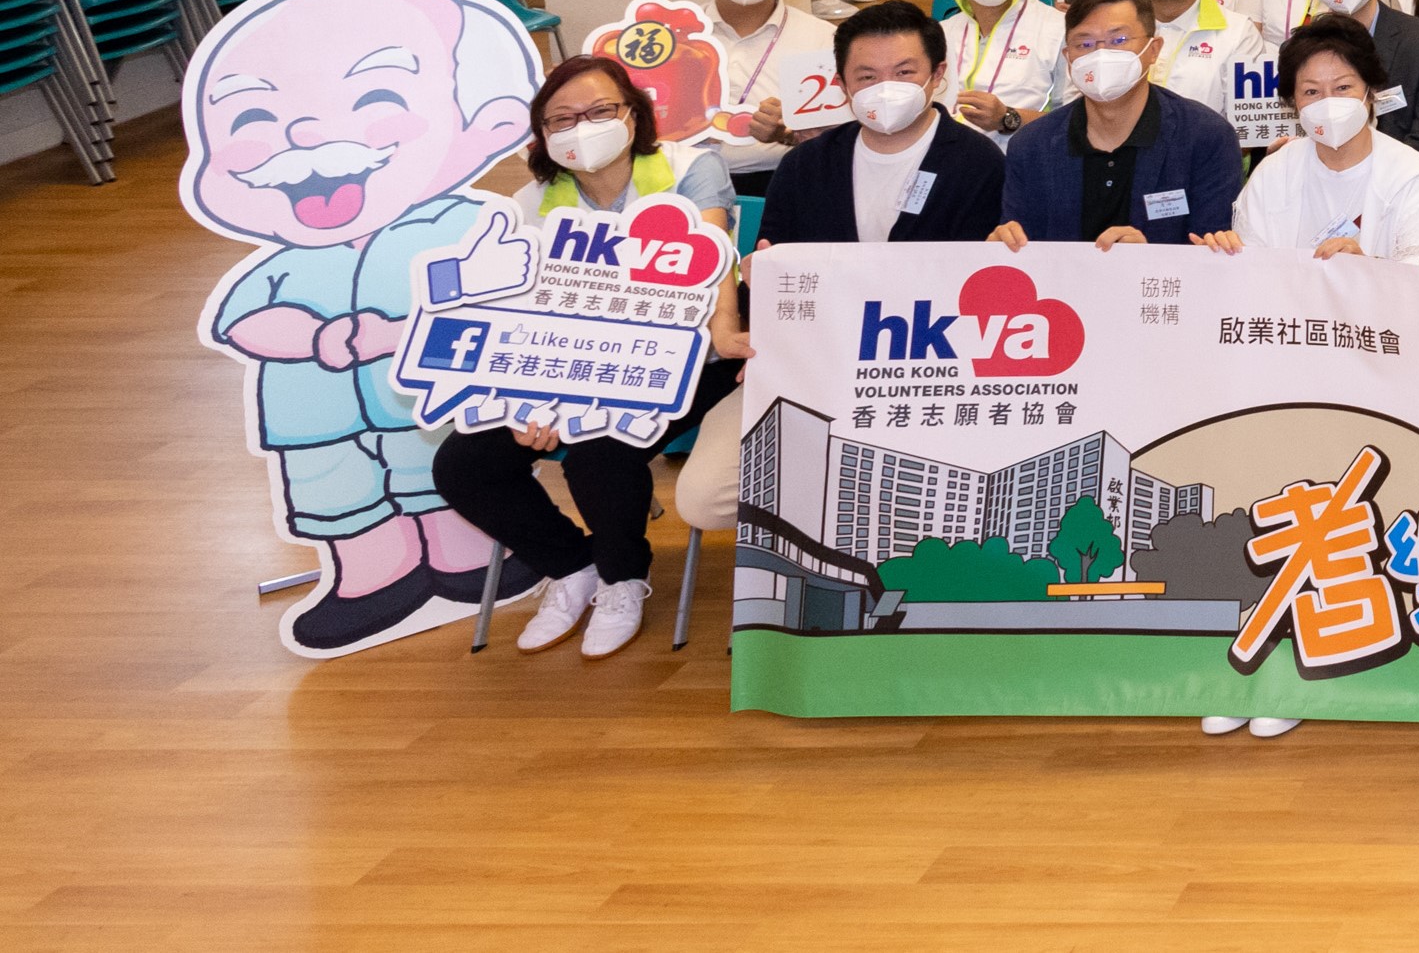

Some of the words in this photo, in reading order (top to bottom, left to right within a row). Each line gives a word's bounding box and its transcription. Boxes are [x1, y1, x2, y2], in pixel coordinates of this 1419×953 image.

[625, 27, 664, 65] 福
[1234, 102, 1263, 111] HONG
[1234, 113, 1299, 122] VOLUNTEERS
[549, 218, 694, 275] hkva
[544, 263, 580, 276] HONG
[583, 267, 619, 280] KONG
[778, 272, 819, 295] 主辦
[540, 276, 621, 293] VOLUNTEERS
[623, 285, 705, 302] ASSOCIATION
[1140, 276, 1182, 299] 協辦
[534, 289, 701, 322] 香港志願者協會
[776, 299, 816, 321] 機構
[1139, 303, 1181, 326] 機構
[857, 299, 1051, 361] hkva
[1218, 317, 1401, 357] 啟業社區協進會
[531, 332, 569, 349] Like
[574, 339, 594, 352] us
[599, 341, 622, 355] on
[631, 339, 658, 357] FB
[488, 352, 673, 390] 香港志願者協會
[856, 367, 905, 380] HONG
[911, 366, 959, 379] KONG
[854, 384, 966, 399] VOLUNTEERS
[970, 383, 1079, 397] ASSOCIATION
[851, 400, 1078, 429] 香港志願者協會
